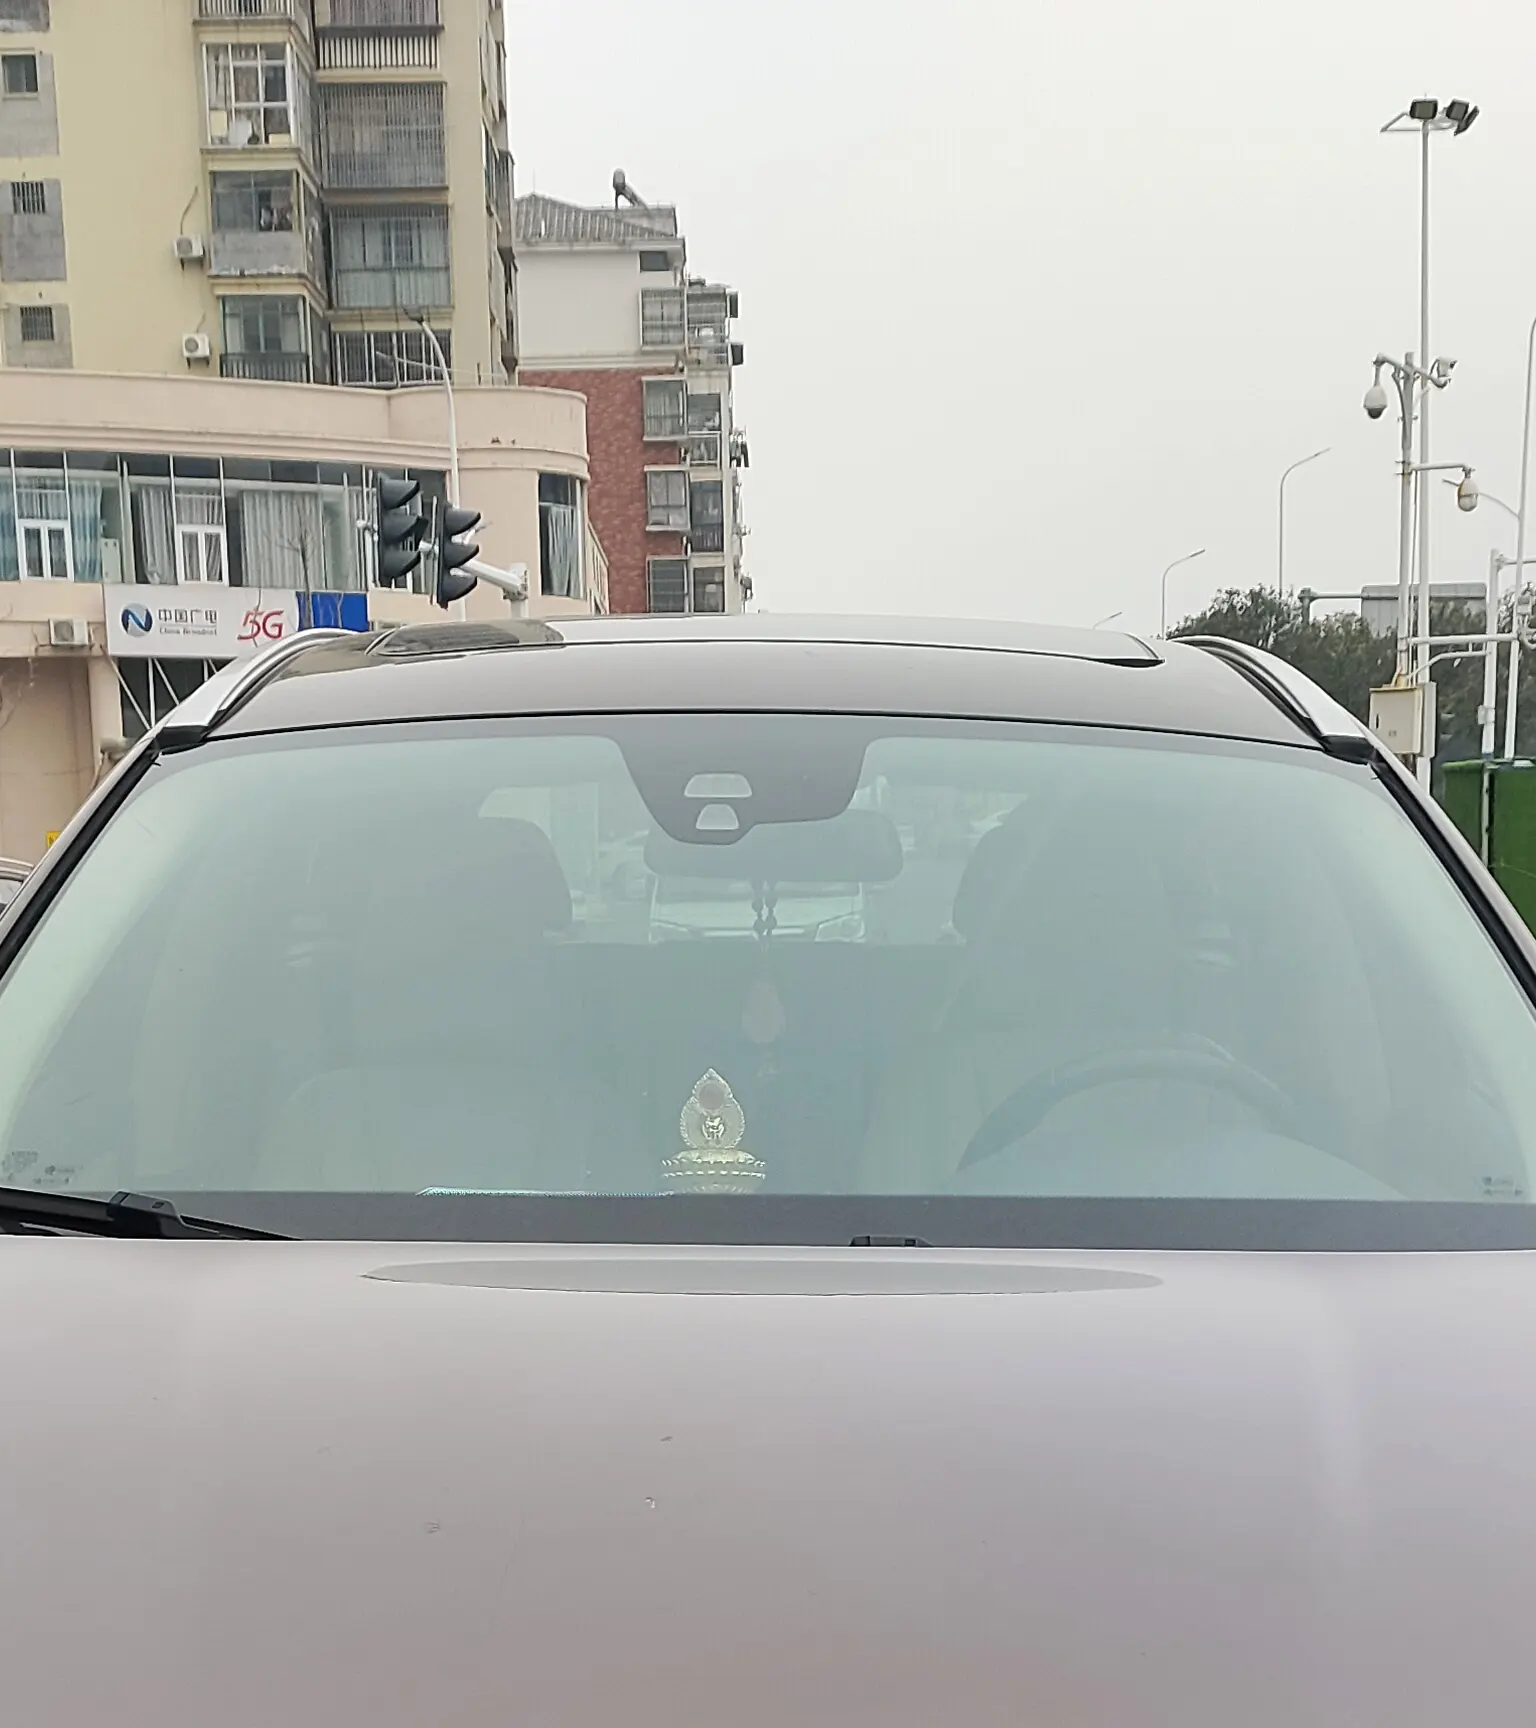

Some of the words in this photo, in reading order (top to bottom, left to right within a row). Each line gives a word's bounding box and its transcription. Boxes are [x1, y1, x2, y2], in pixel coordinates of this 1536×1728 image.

[158, 608, 217, 623] 中国广电
[237, 610, 285, 641] 5G
